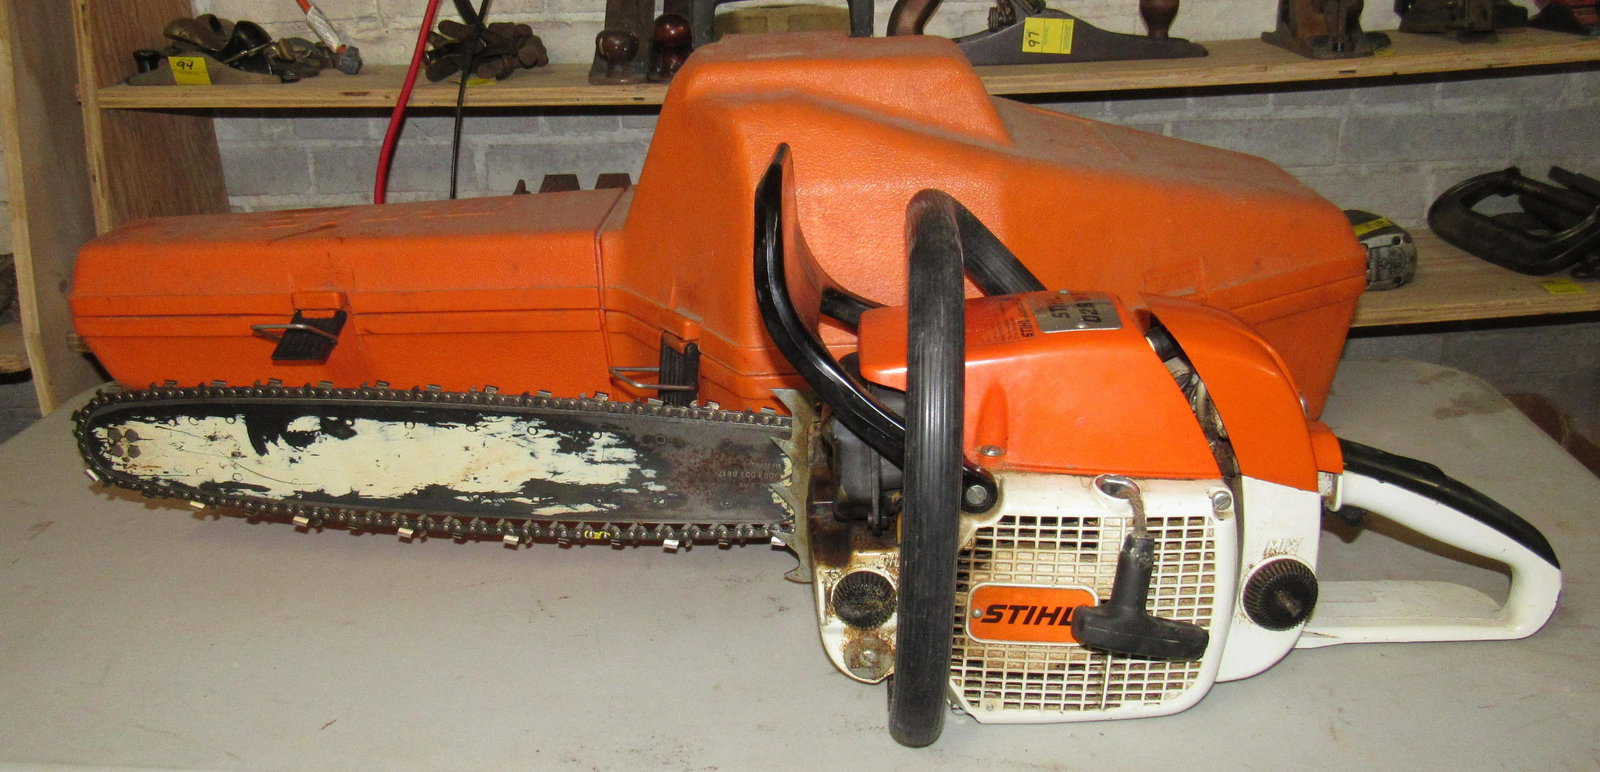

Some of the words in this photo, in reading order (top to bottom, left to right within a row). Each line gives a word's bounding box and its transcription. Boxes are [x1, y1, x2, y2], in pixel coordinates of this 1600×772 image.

[1028, 31, 1041, 48] 97
[176, 60, 194, 71] 94
[981, 604, 1074, 626] STIHL
